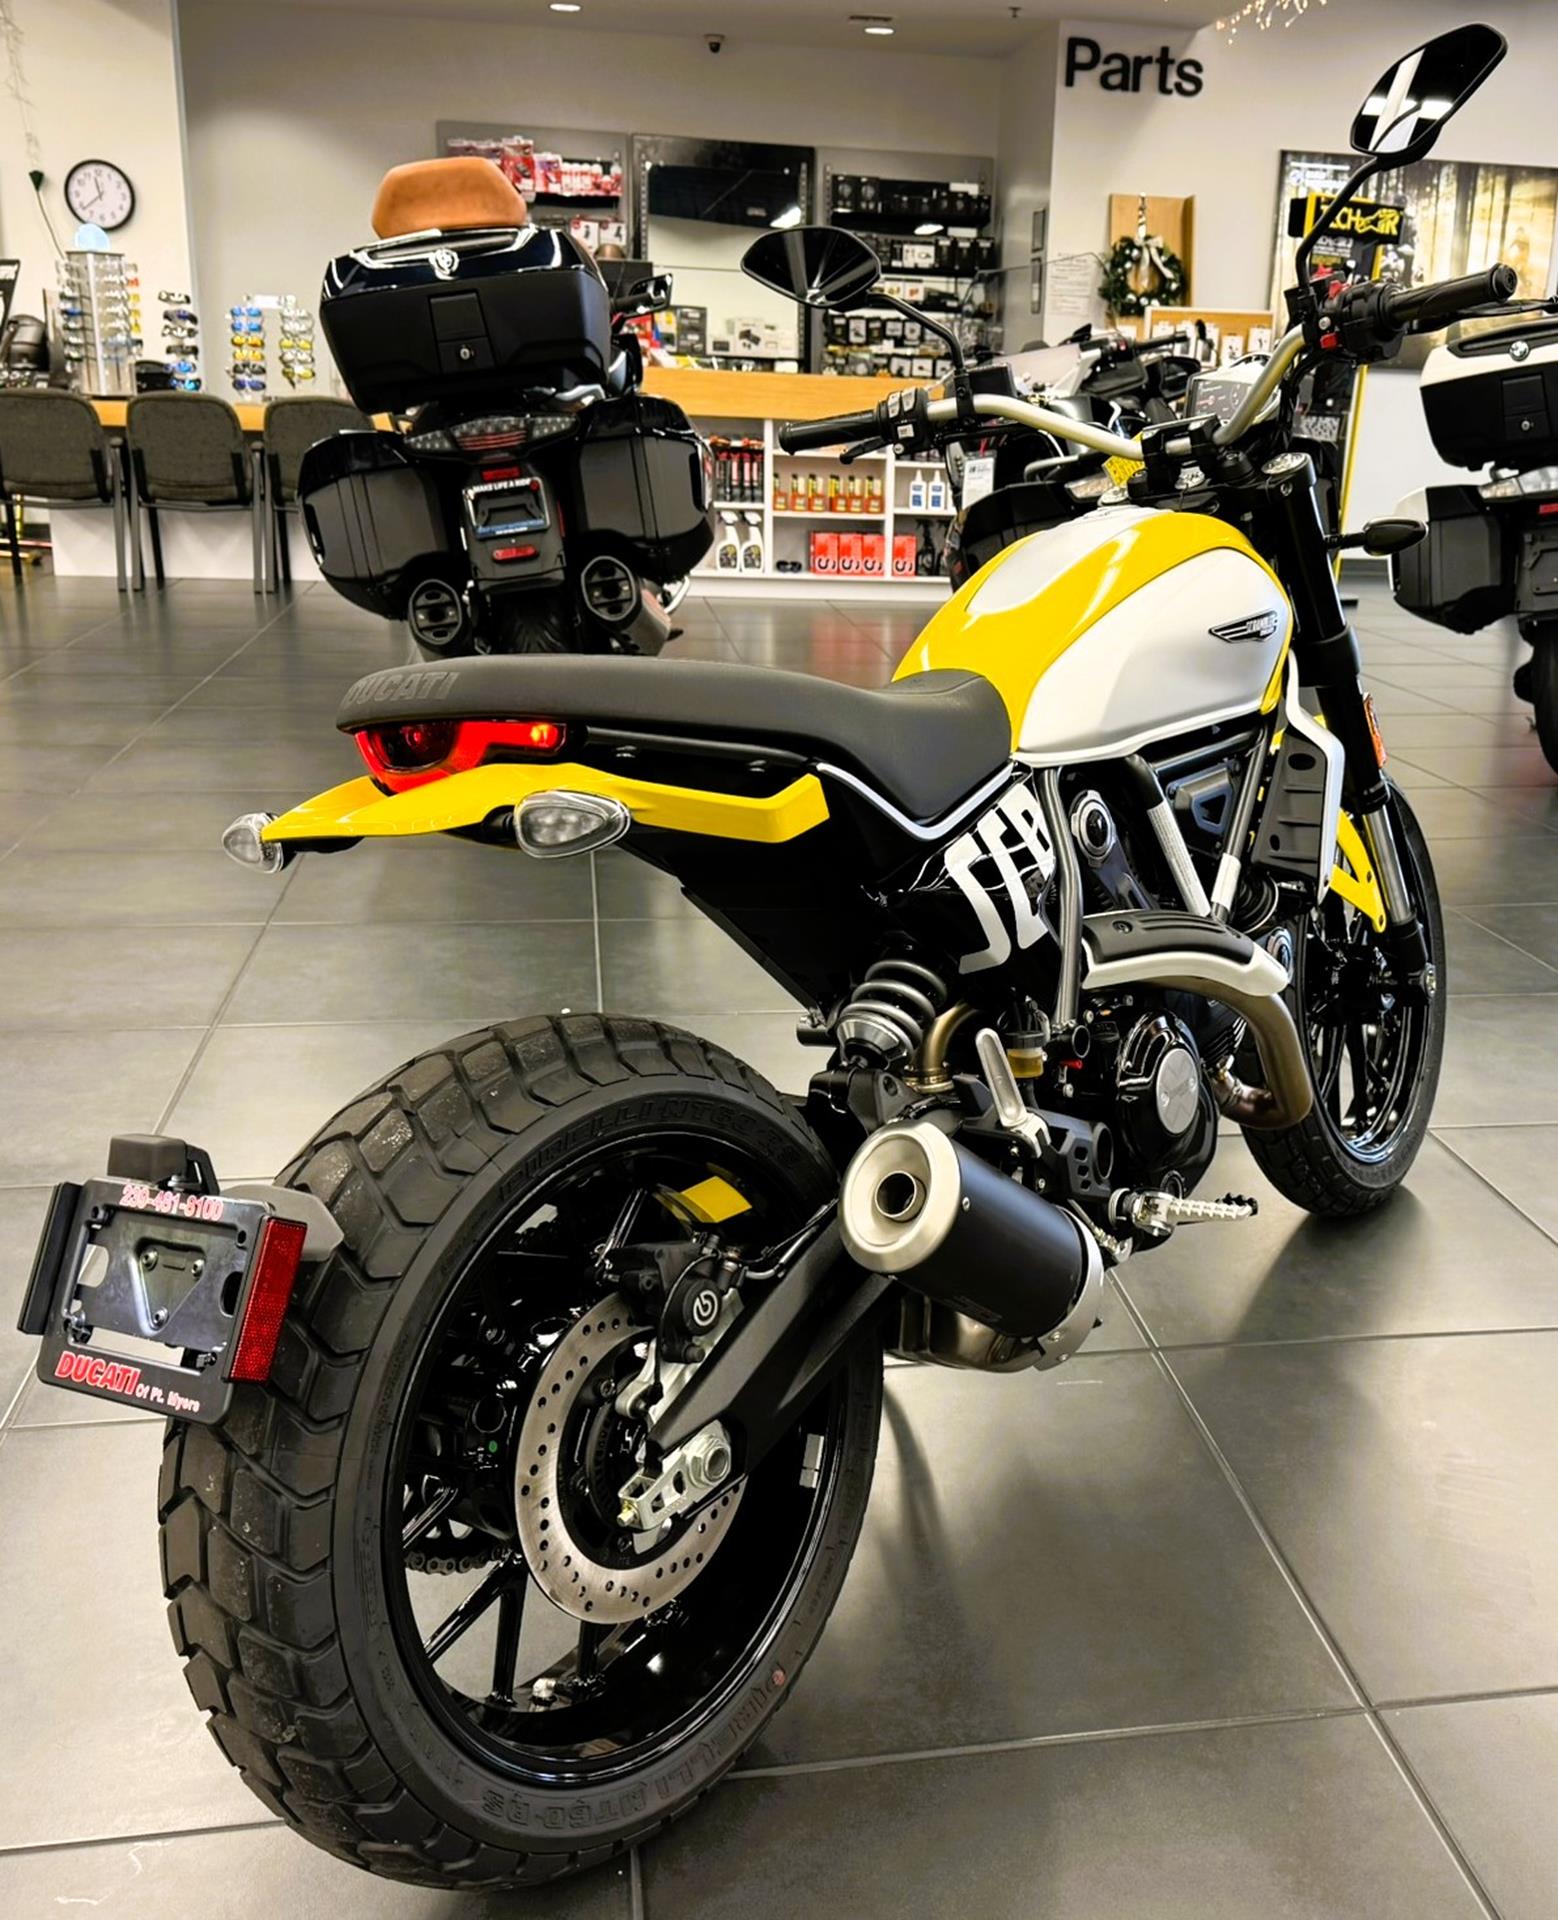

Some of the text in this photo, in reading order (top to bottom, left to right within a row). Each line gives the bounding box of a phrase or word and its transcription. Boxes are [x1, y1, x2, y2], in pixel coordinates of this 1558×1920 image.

[1065, 37, 1203, 97] Parts
[494, 481, 508, 490] LIFE
[341, 671, 460, 709] DUCATI
[55, 1351, 141, 1395] DUCATI
[167, 1391, 201, 1412] Myers
